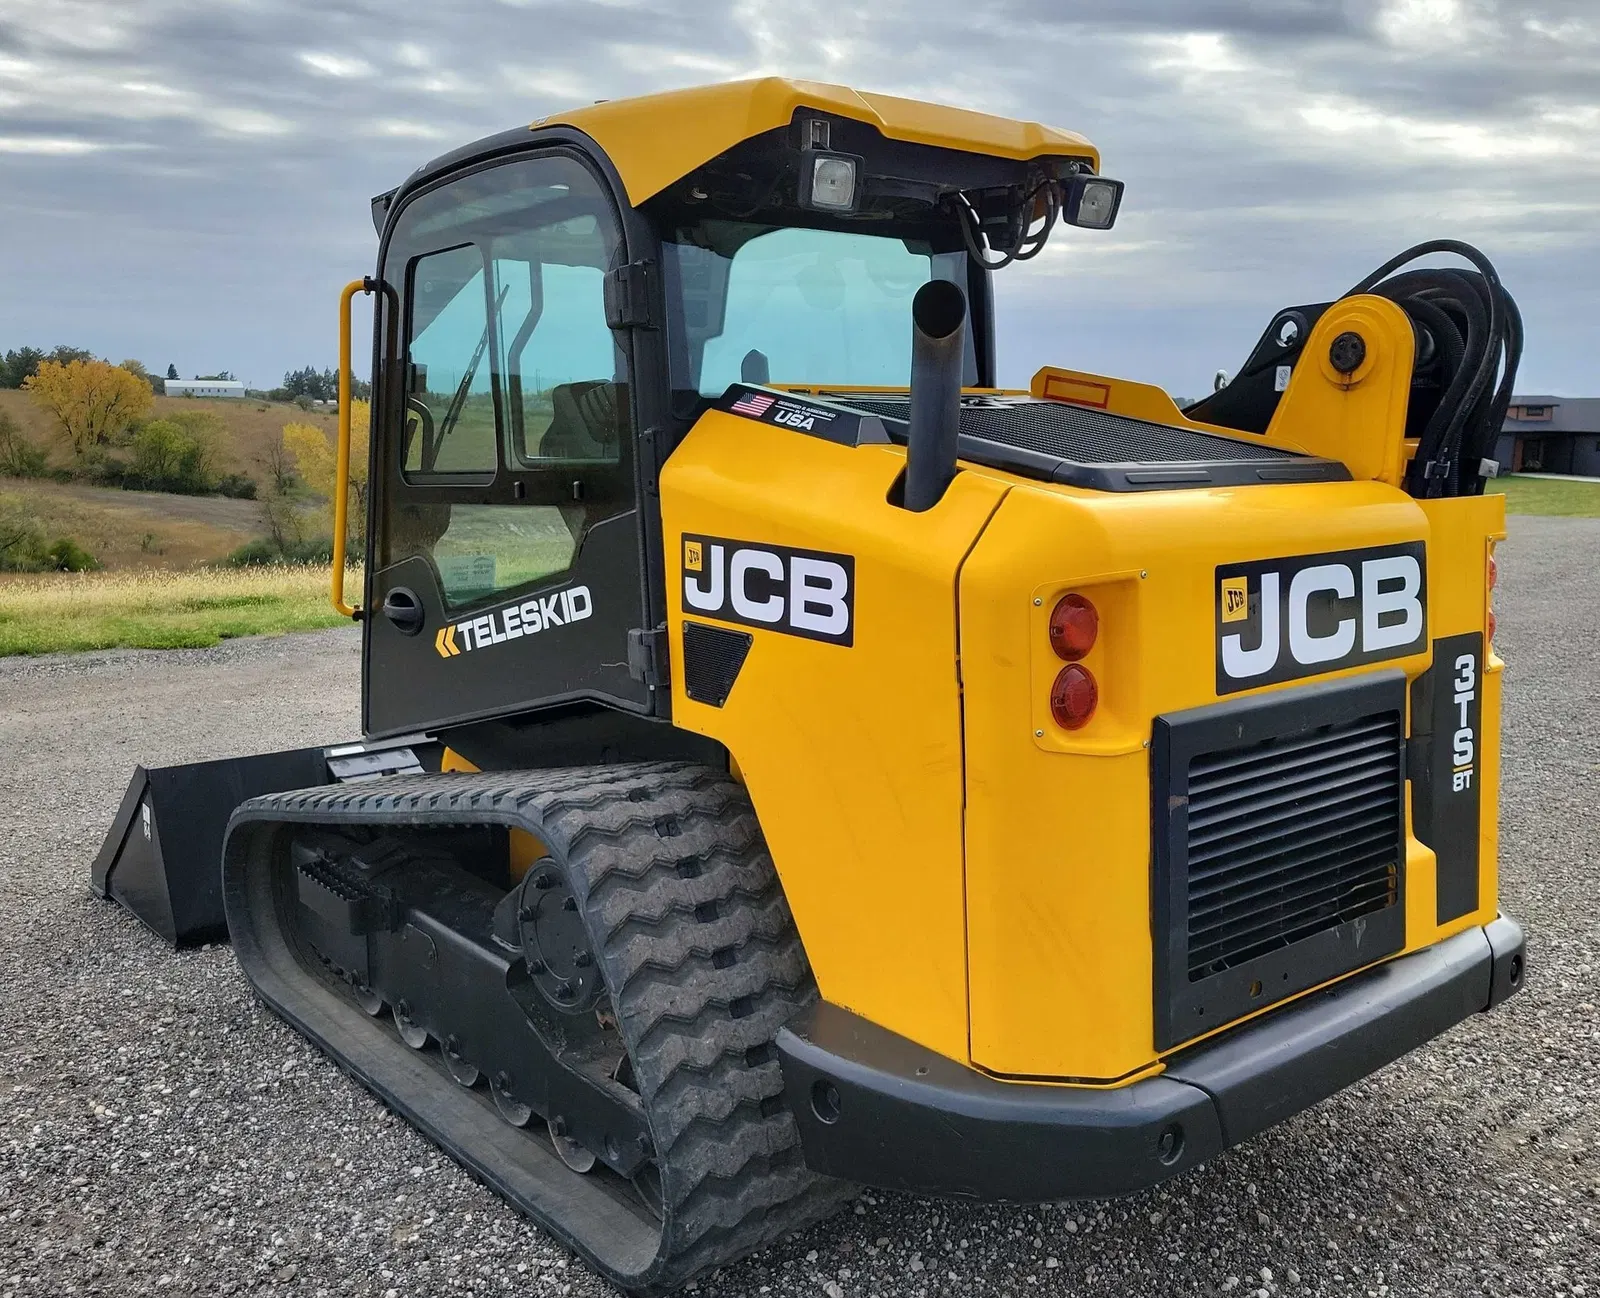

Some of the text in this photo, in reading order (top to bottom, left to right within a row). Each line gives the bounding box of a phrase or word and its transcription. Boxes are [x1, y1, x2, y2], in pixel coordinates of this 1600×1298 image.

[774, 410, 815, 430] USA
[457, 585, 593, 652] TELESKID
[685, 544, 849, 635] JCB
[1222, 555, 1423, 679] JCB
[1227, 590, 1244, 612] JCB
[1453, 654, 1475, 766] 3TS
[1453, 769, 1473, 792] 8T
